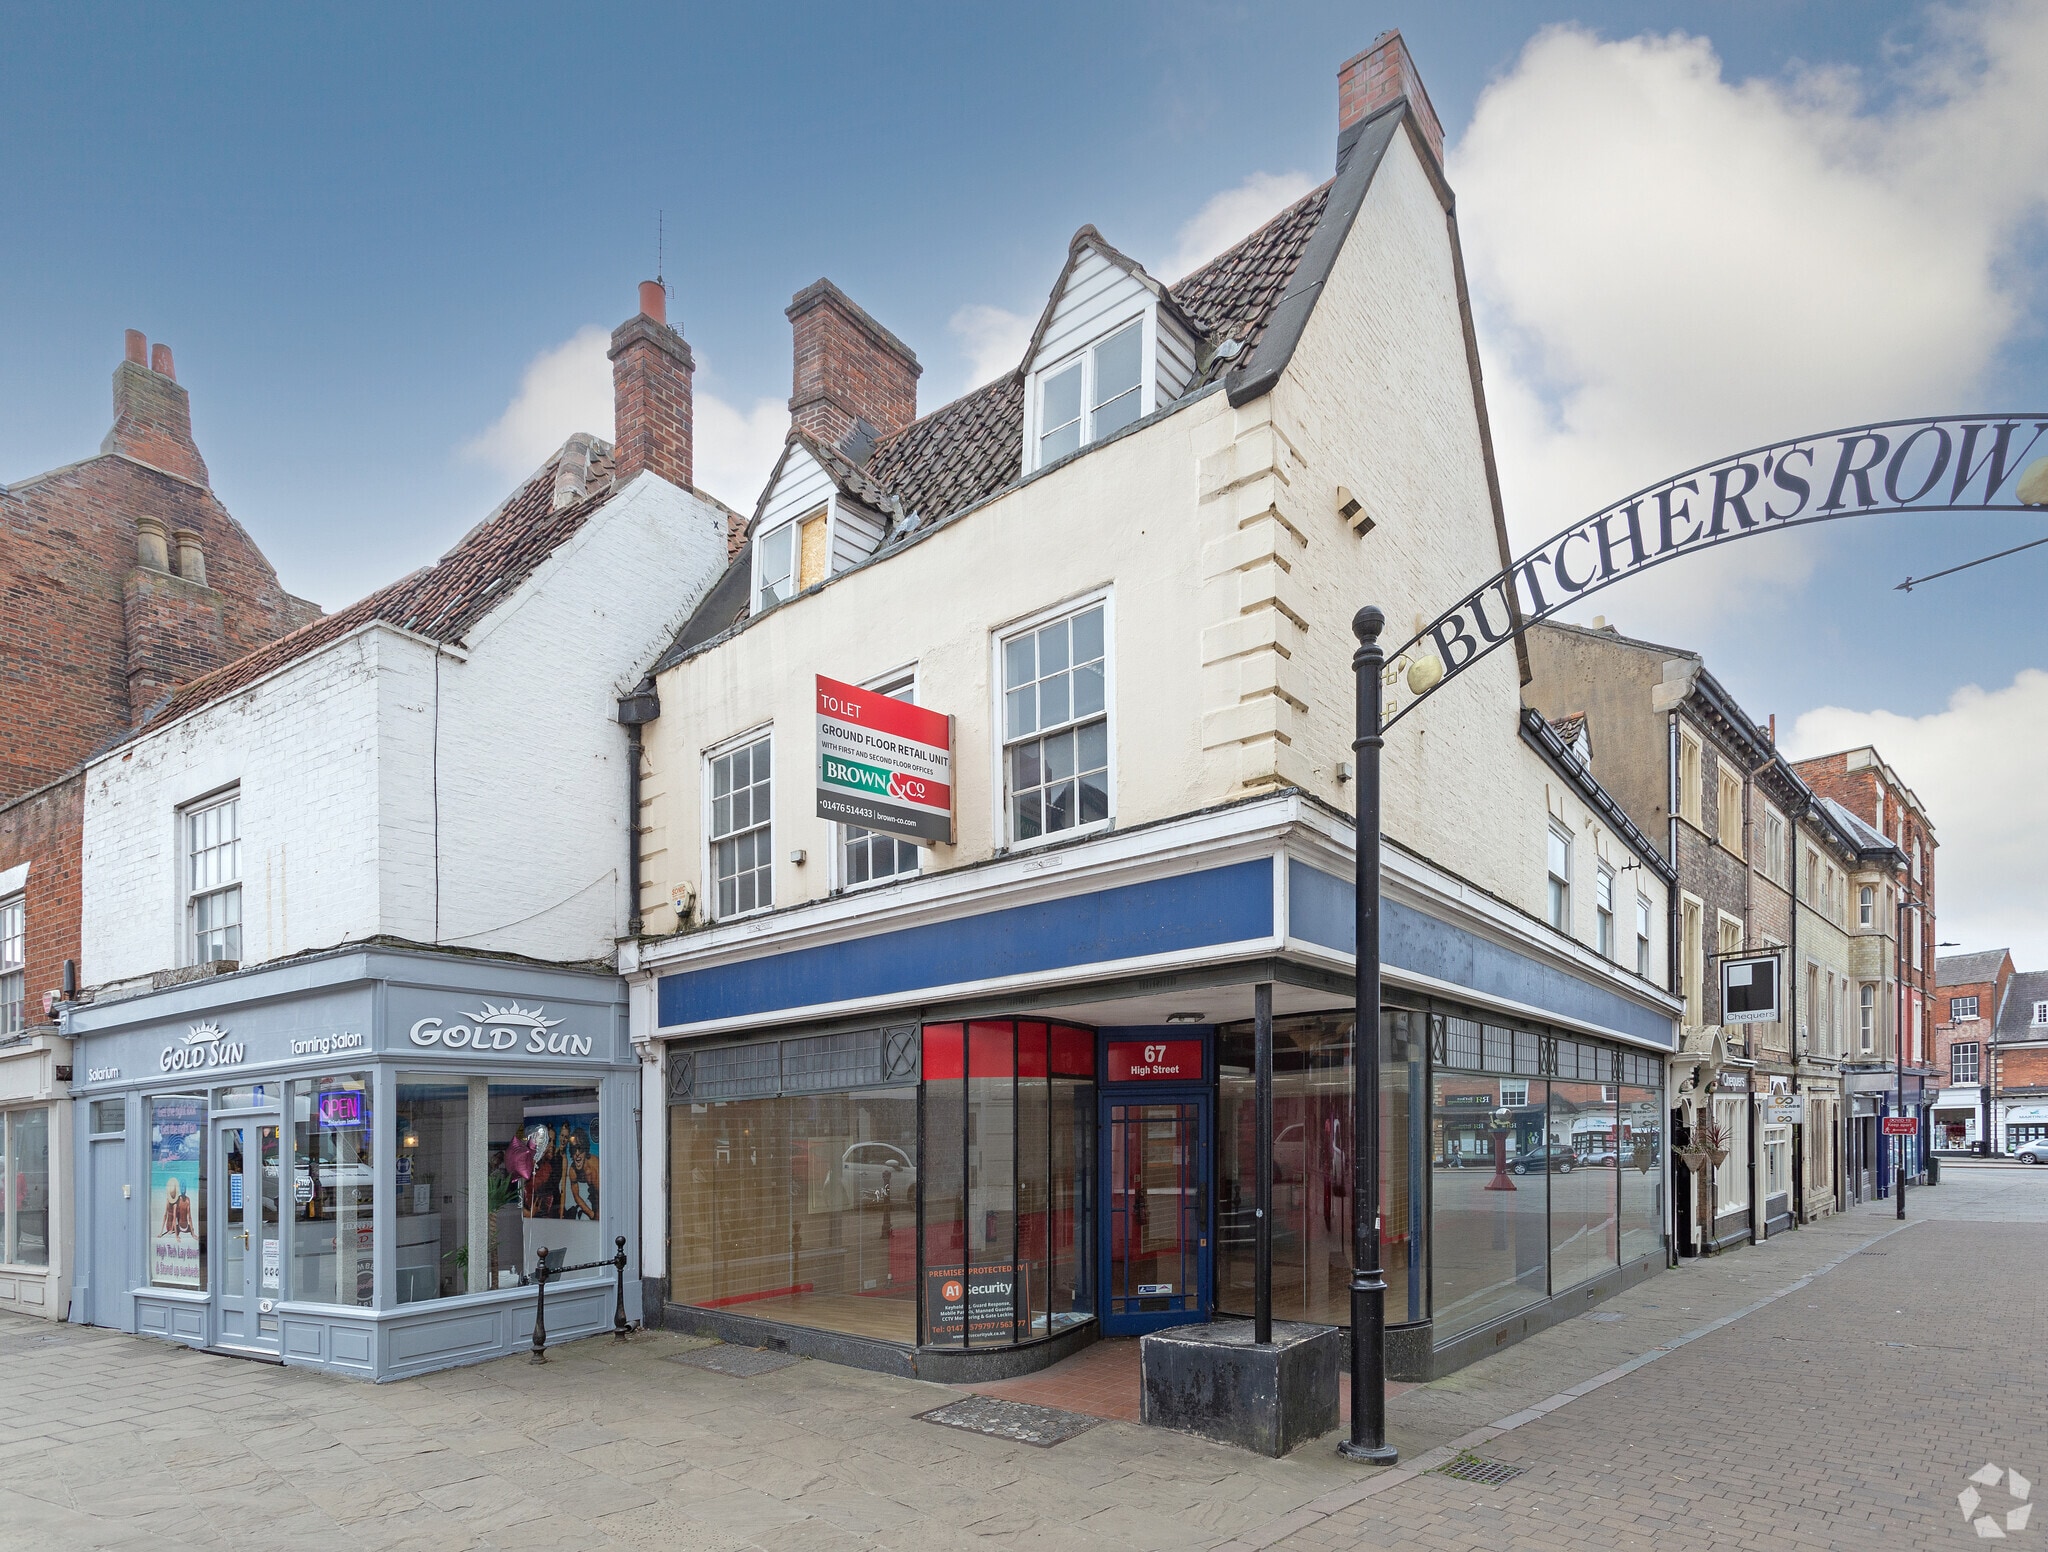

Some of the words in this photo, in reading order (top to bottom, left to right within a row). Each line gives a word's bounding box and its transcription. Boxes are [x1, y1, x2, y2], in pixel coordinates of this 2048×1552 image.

[1427, 447, 1814, 677] BUTCHER'S
[1816, 423, 2048, 512] ROW
[821, 694, 839, 712] TO
[840, 700, 861, 718] LET
[822, 723, 864, 743] GROUND
[865, 736, 897, 752] FLOOR
[898, 744, 927, 760] RETAIL
[929, 752, 948, 766] UNIT
[822, 740, 838, 750] WITH
[838, 745, 855, 755] FIRST
[856, 749, 869, 759] AND
[869, 754, 893, 765] SECOND
[893, 760, 911, 769] FLOOR
[912, 764, 934, 775] OFFICES
[822, 799, 845, 812] 01476
[846, 804, 873, 818] 514433
[877, 812, 917, 827] brown-co.com
[1727, 1011, 1775, 1021] Chequers
[290, 1037, 330, 1054] Tanning
[331, 1032, 362, 1050] Salon
[409, 1018, 518, 1050] GOLD
[525, 1027, 593, 1056] SUN
[159, 1046, 205, 1072] GOLD
[208, 1040, 244, 1066] SUN
[1144, 1045, 1167, 1063] 67
[88, 1067, 119, 1082] Solarium
[1131, 1065, 1151, 1076] High
[1152, 1065, 1179, 1074] Street
[321, 1097, 358, 1119] OPEN
[968, 1265, 1012, 1275] PROTECTED
[946, 1285, 960, 1297] A1
[932, 1325, 945, 1333] Tel:
[946, 1323, 966, 1332] 0147
[1000, 1320, 1026, 1328] 56377
